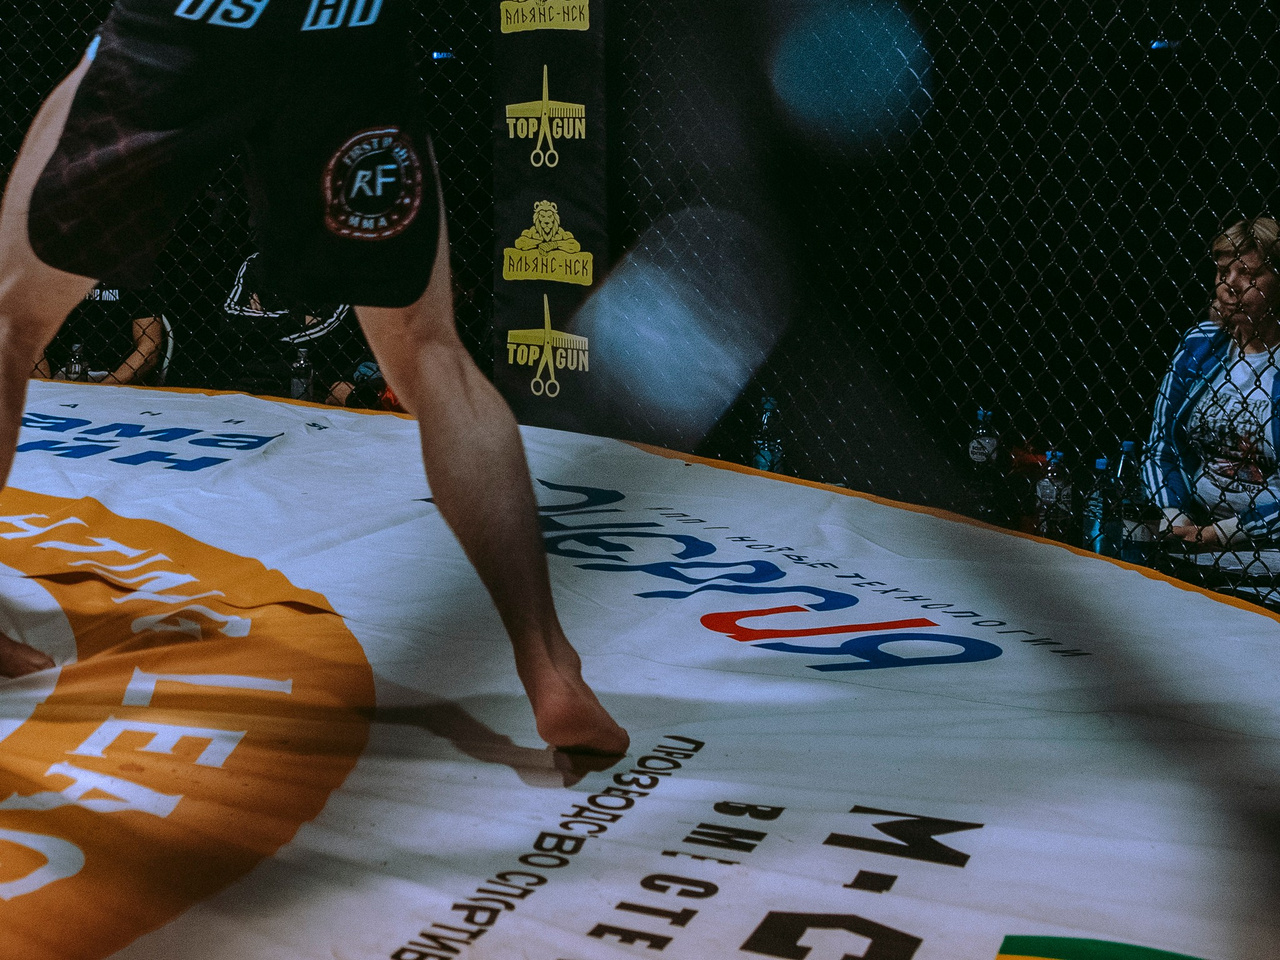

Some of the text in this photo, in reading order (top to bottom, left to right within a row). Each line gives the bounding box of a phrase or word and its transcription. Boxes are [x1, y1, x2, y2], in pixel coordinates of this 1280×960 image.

[505, 4, 586, 26] АЛЬЯНС-НСК
[506, 118, 586, 140] TOP GUN
[349, 164, 397, 199] RF
[507, 255, 590, 277] АЛЬЯНС-НСК
[506, 343, 589, 372] TOP GUN
[835, 572, 1093, 658] ТЕХНОЛОГИИ
